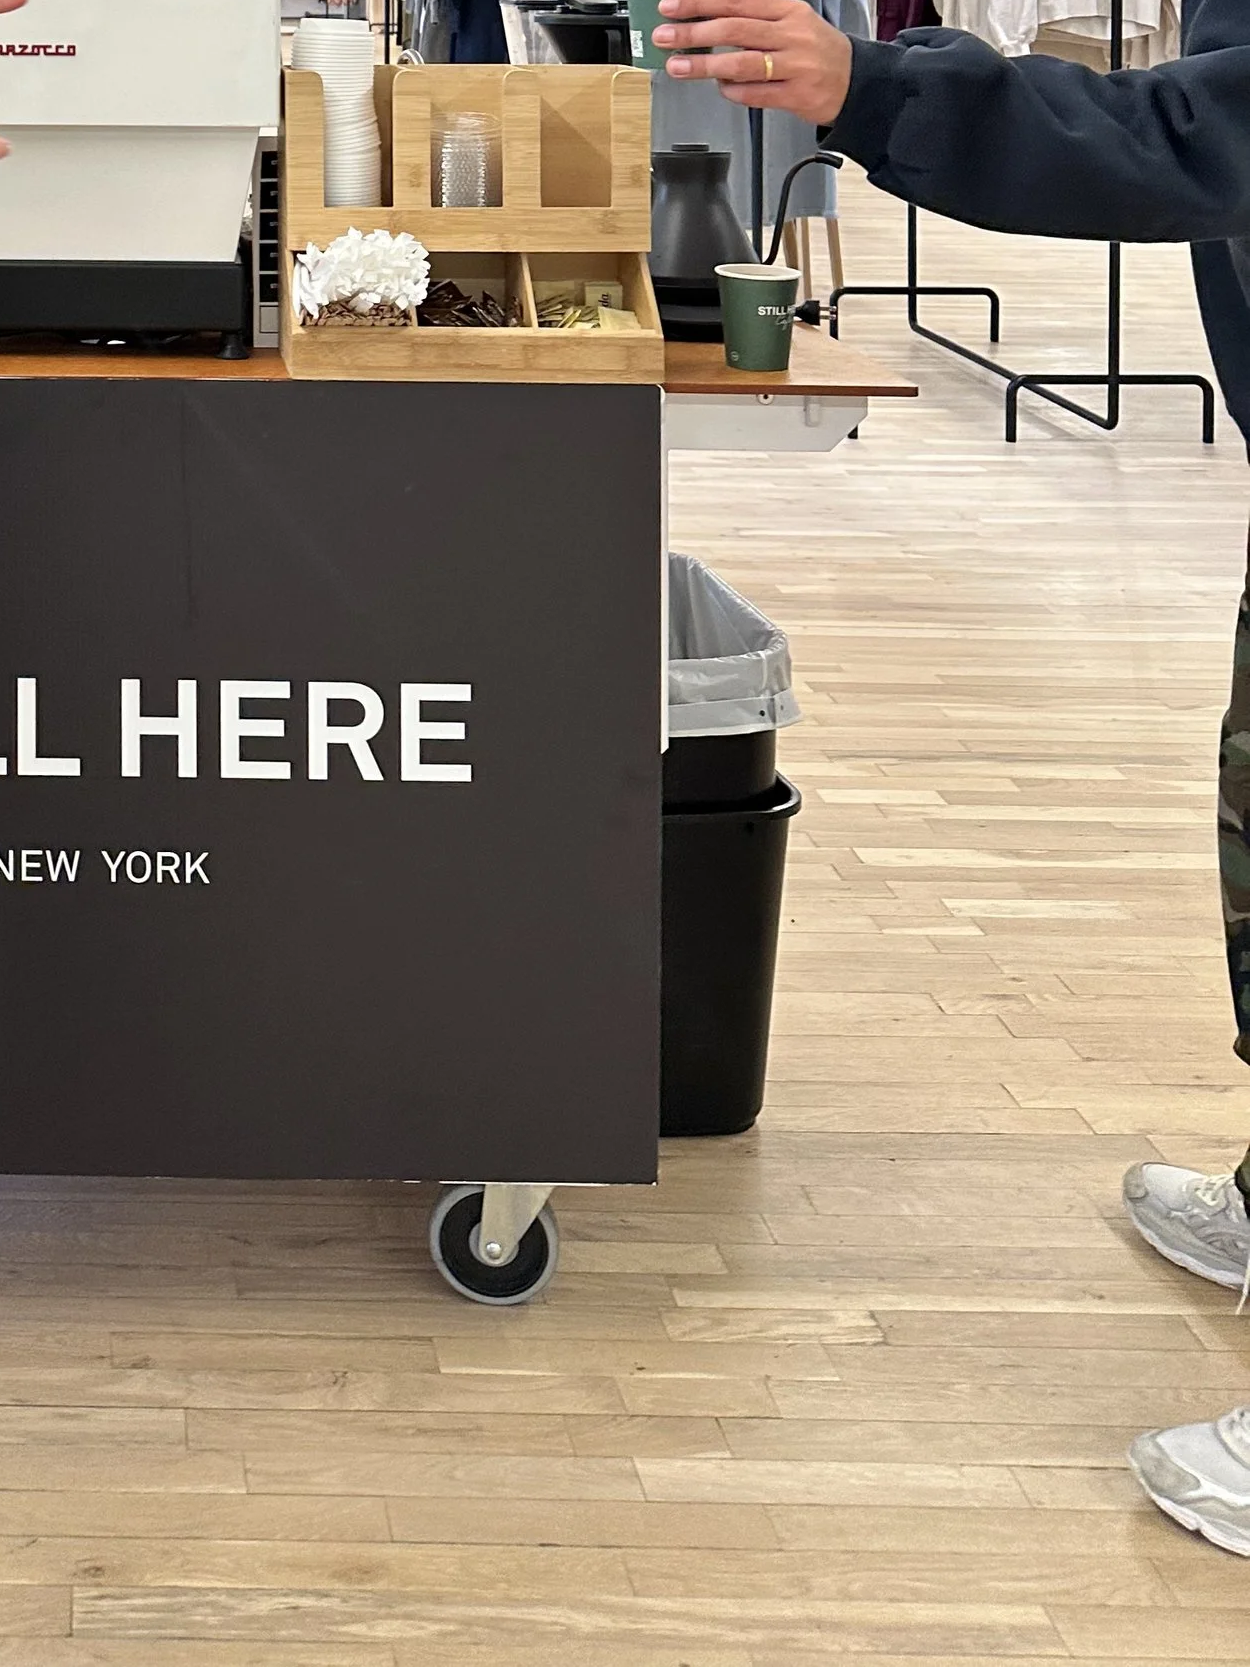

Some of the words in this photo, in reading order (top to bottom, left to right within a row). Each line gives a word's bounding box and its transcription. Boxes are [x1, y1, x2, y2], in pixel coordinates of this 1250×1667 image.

[757, 306, 786, 316] STILL
[121, 678, 472, 783] HERE
[101, 850, 211, 884] YORK
